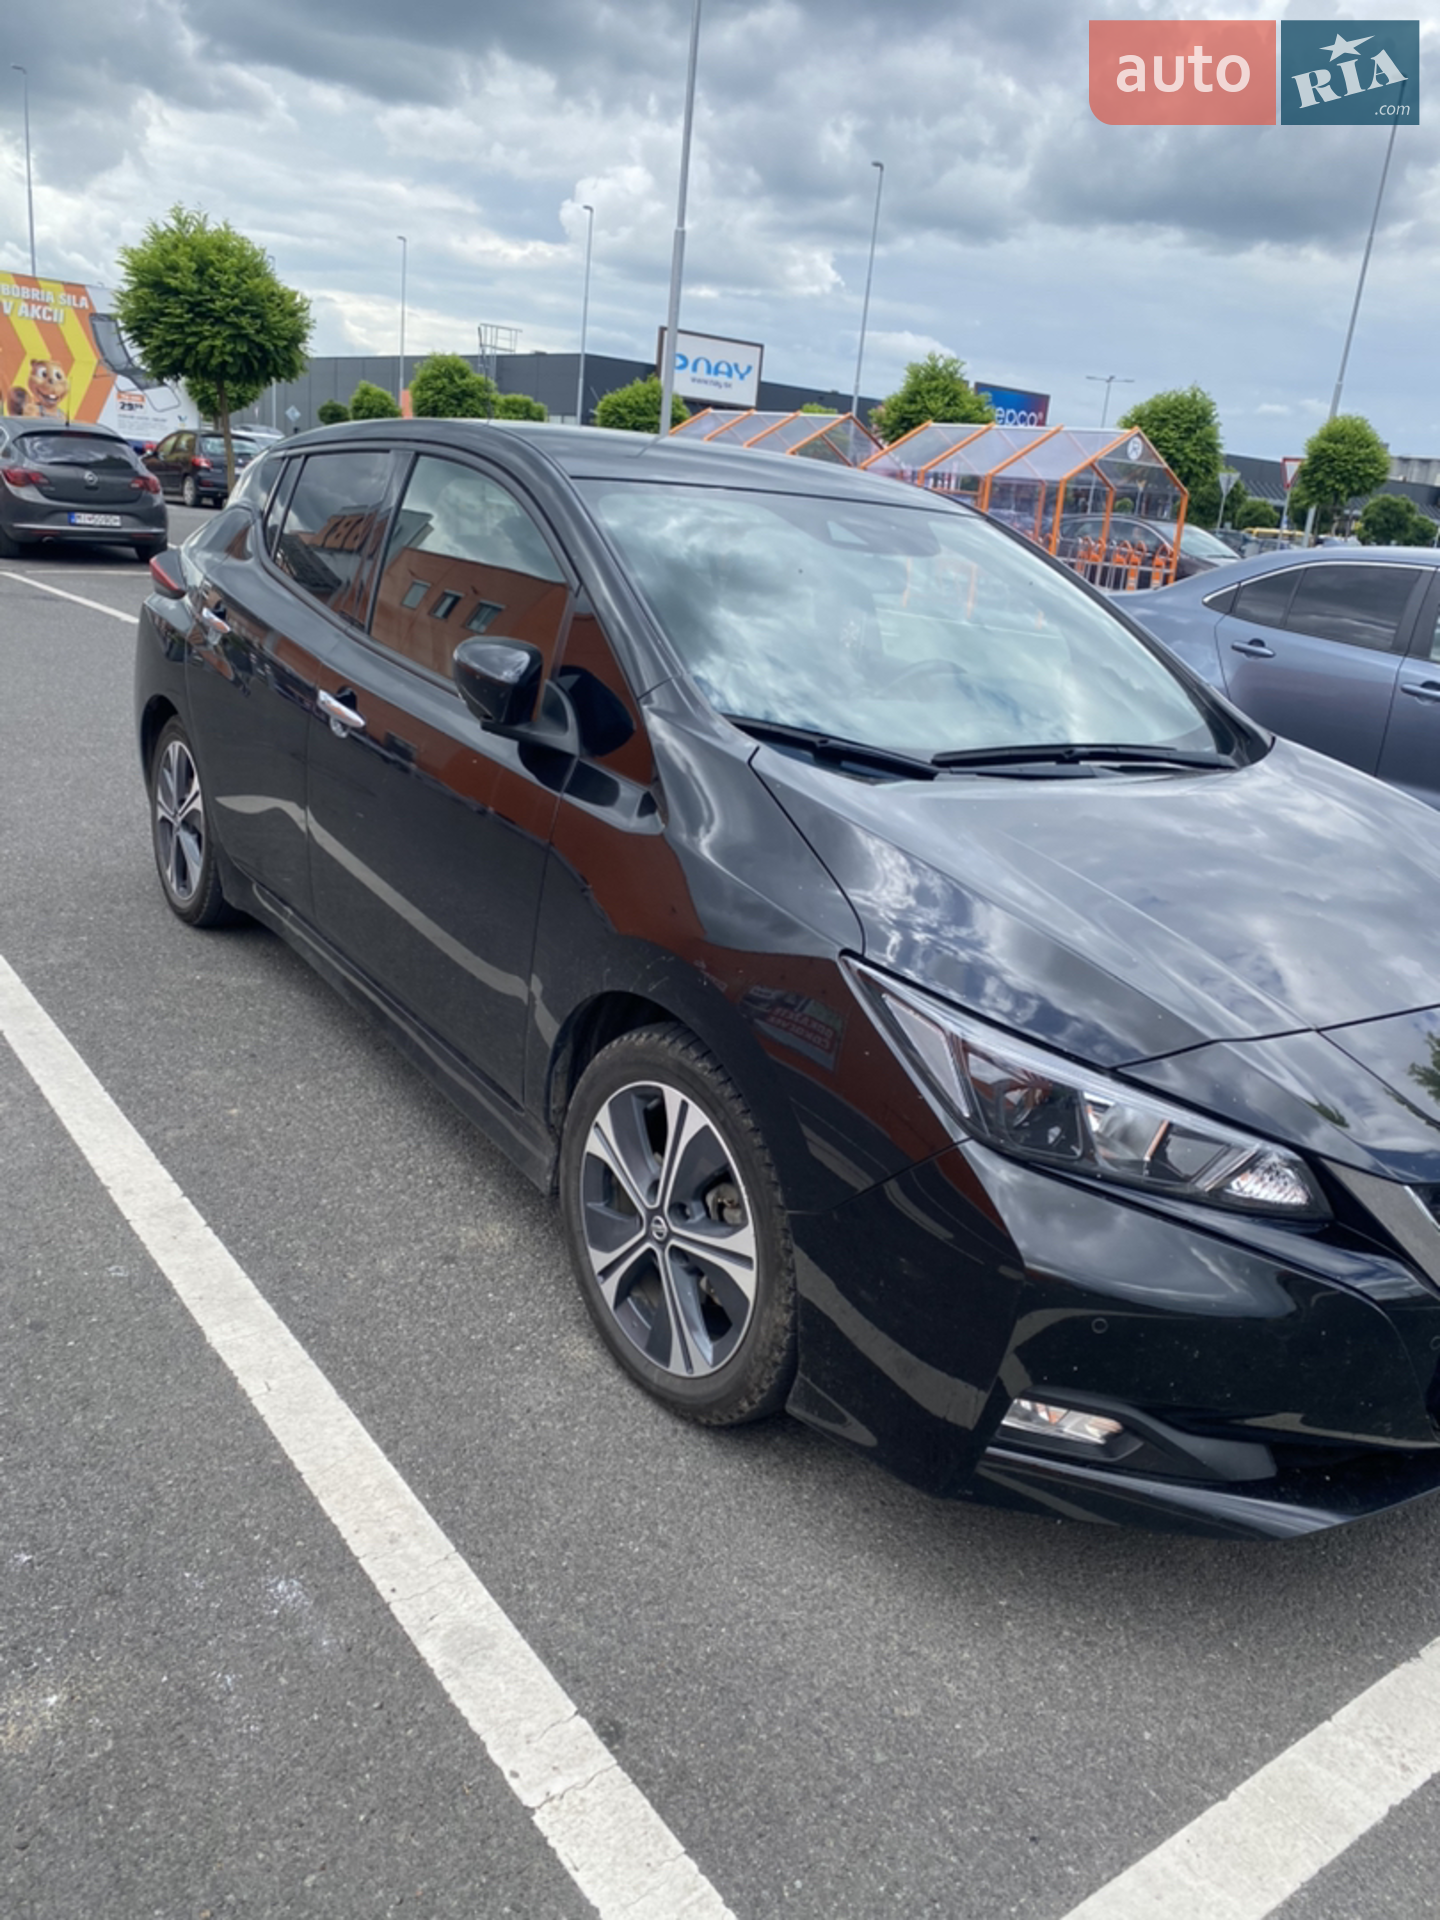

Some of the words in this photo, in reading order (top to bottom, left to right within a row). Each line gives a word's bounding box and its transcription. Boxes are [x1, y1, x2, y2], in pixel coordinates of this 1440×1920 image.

[2, 284, 55, 304] BOBRIA
[60, 294, 89, 309] SILA
[3, 300, 13, 315] V
[18, 302, 64, 323] AKCII
[691, 356, 753, 381] NAY
[994, 406, 1038, 424] epco
